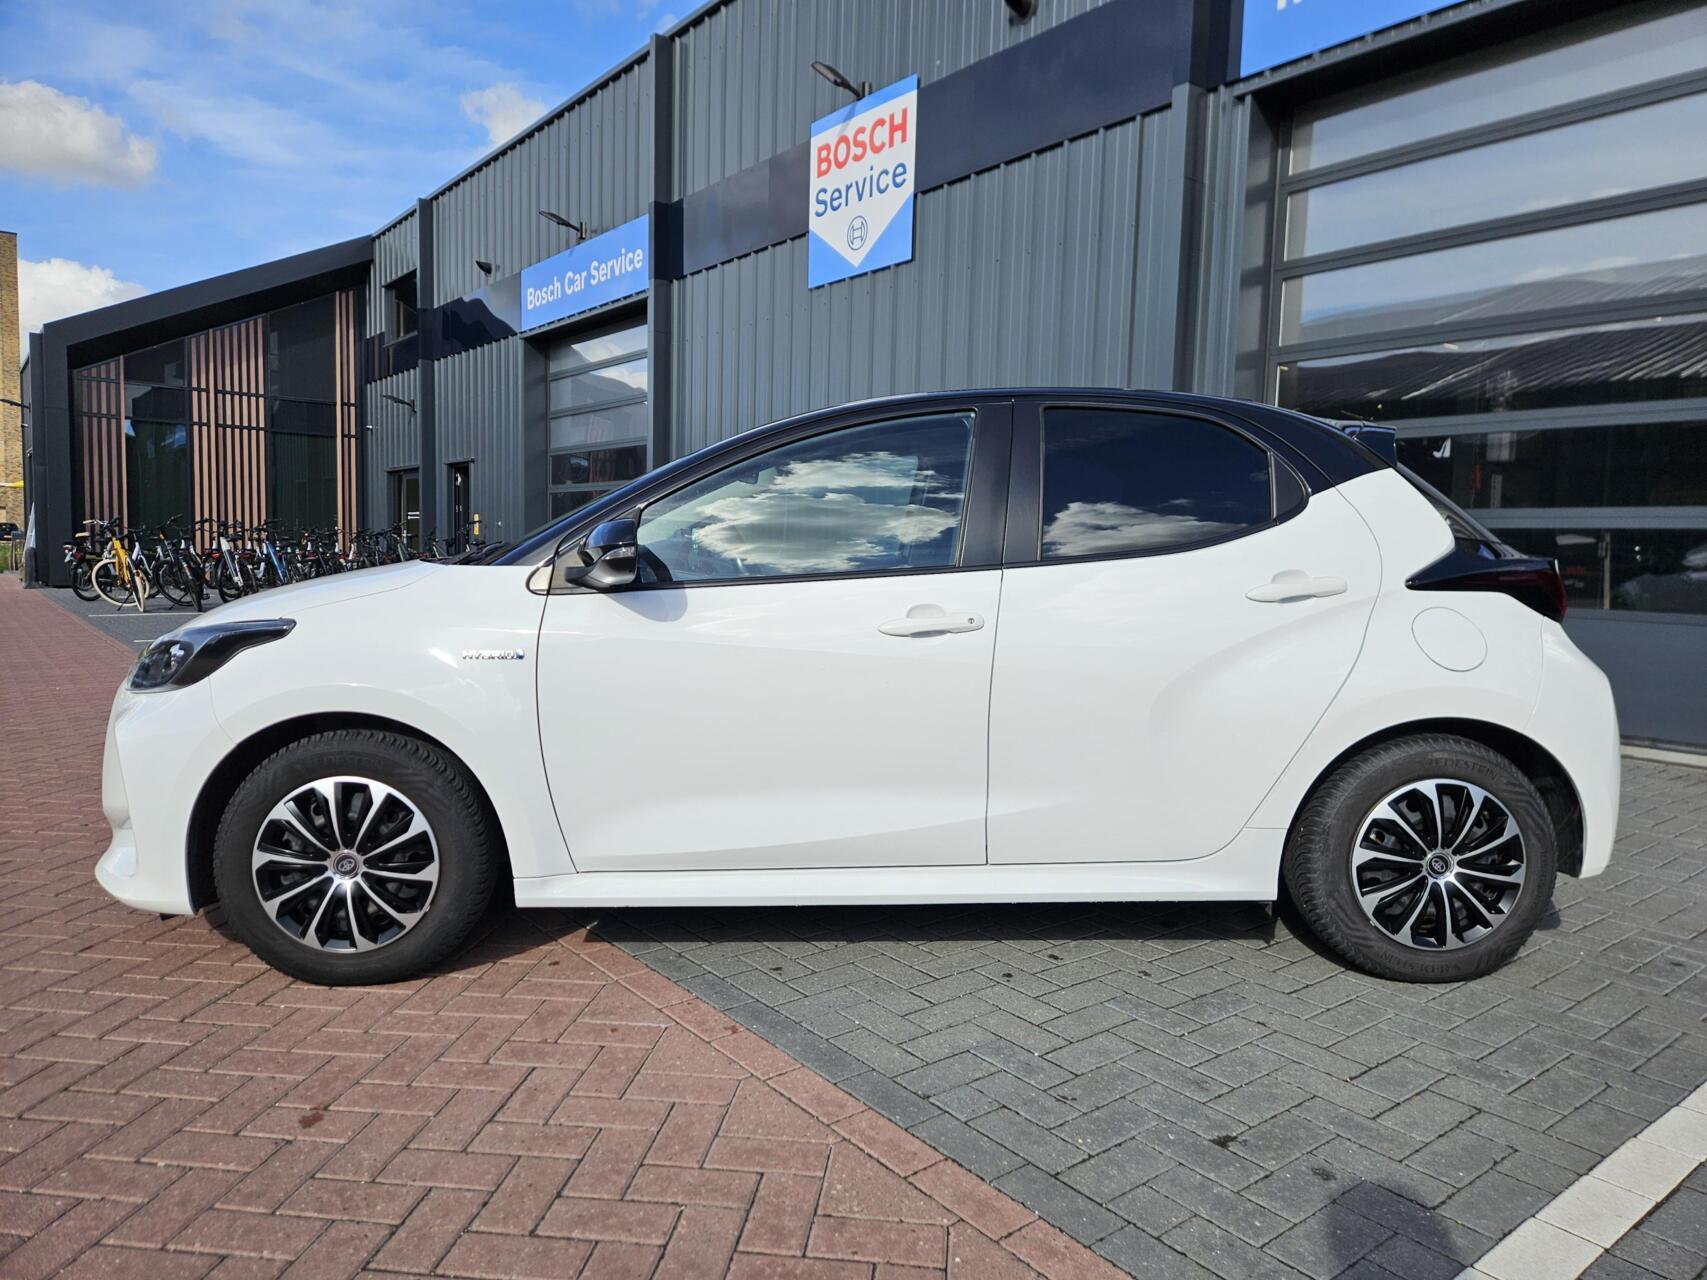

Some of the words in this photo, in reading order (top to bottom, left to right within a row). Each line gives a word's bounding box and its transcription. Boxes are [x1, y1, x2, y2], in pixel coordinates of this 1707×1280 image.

[816, 107, 908, 179] BOSCH
[814, 162, 907, 217] Service
[527, 276, 561, 310] Bosch
[564, 270, 587, 295] Car
[590, 248, 643, 285] Service
